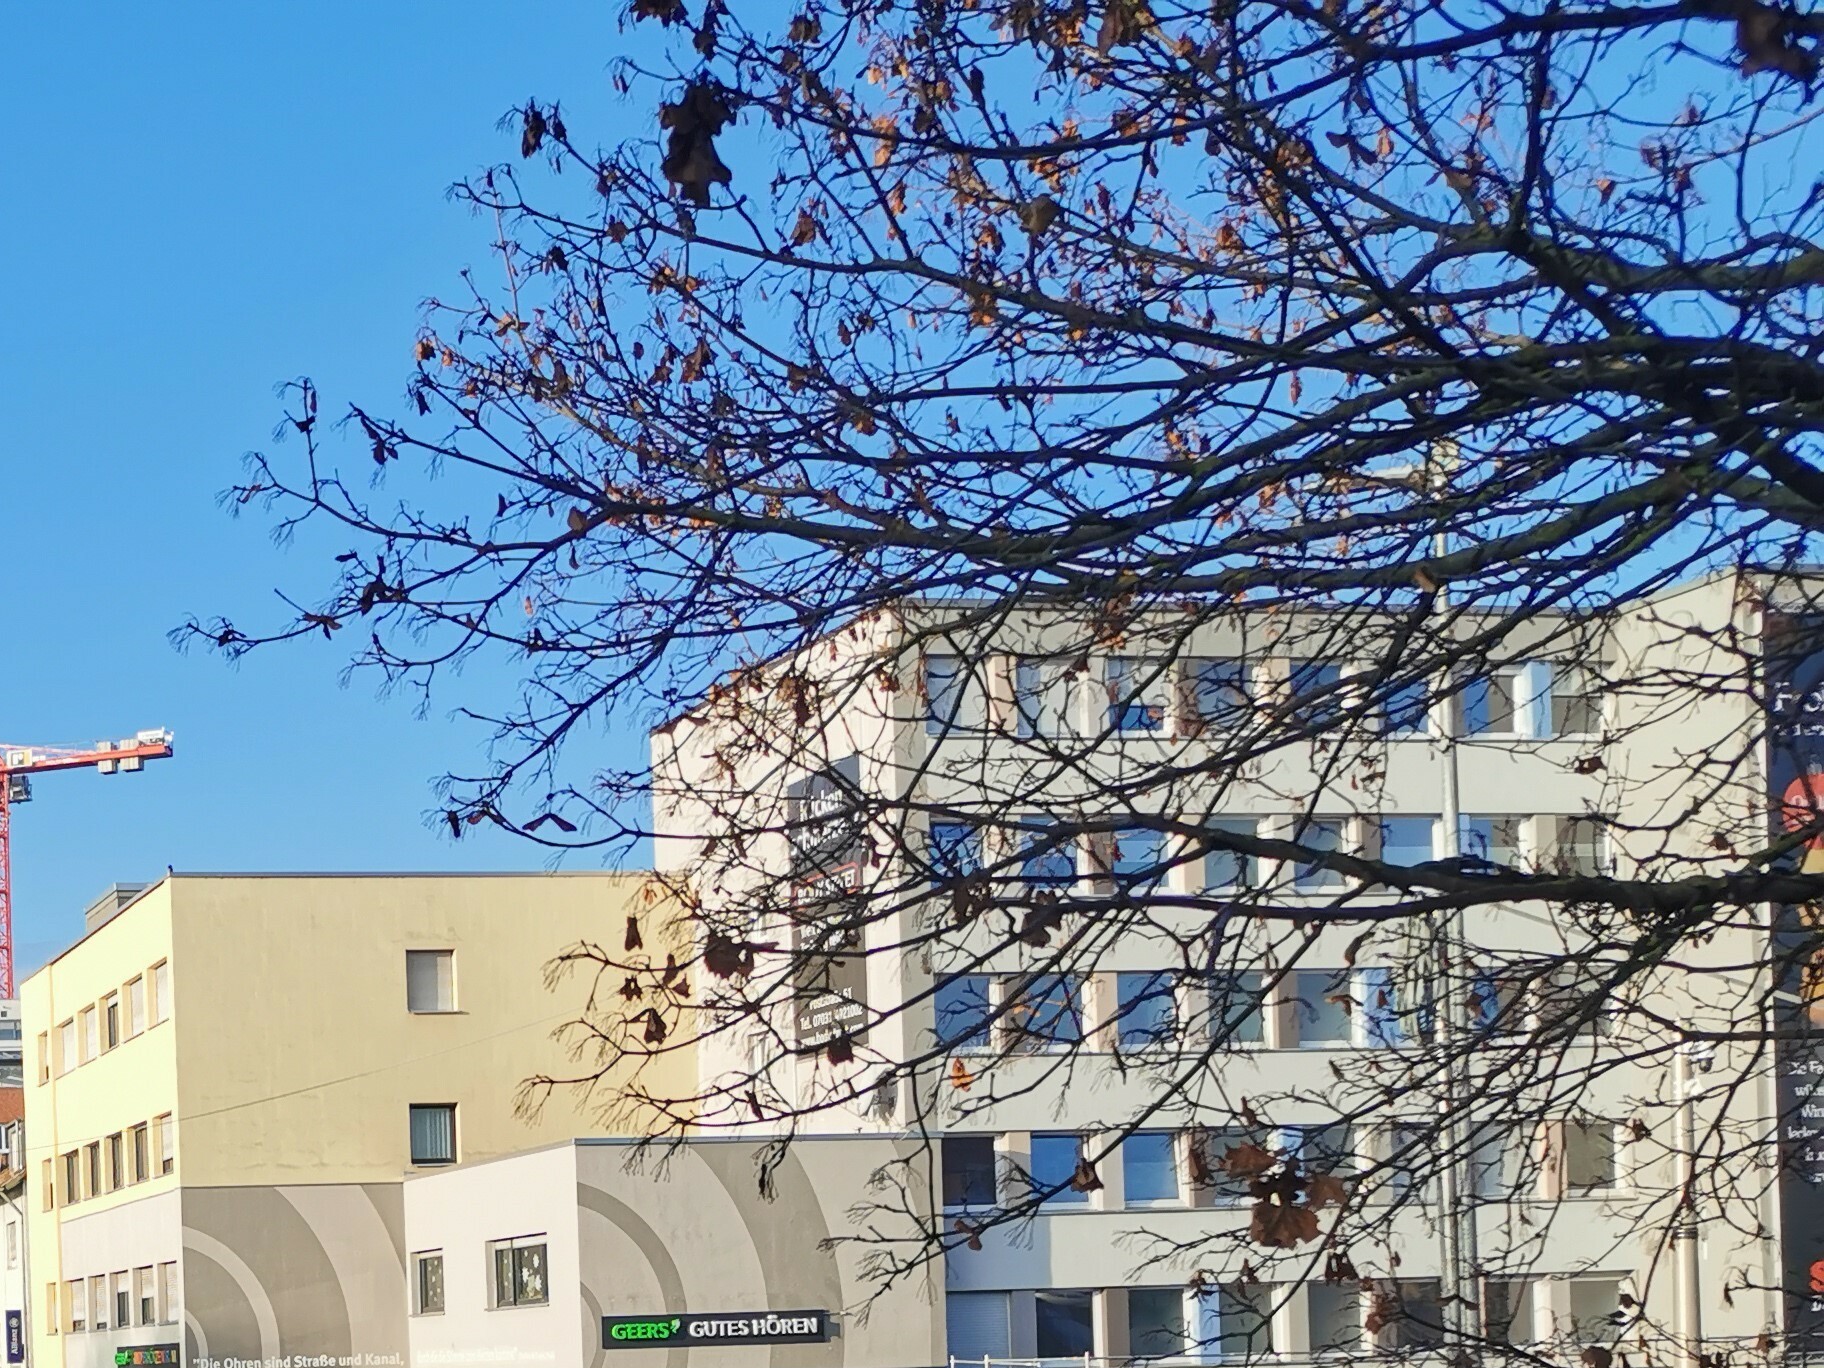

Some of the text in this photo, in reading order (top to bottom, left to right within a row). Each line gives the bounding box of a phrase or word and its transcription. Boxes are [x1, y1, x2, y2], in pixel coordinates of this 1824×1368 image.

[611, 1314, 818, 1340] GEERS GUTES HÖREN
[264, 1355, 291, 1368] sind
[293, 1354, 336, 1368] Straße
[338, 1354, 362, 1367] und
[365, 1352, 405, 1366] Kanal,
